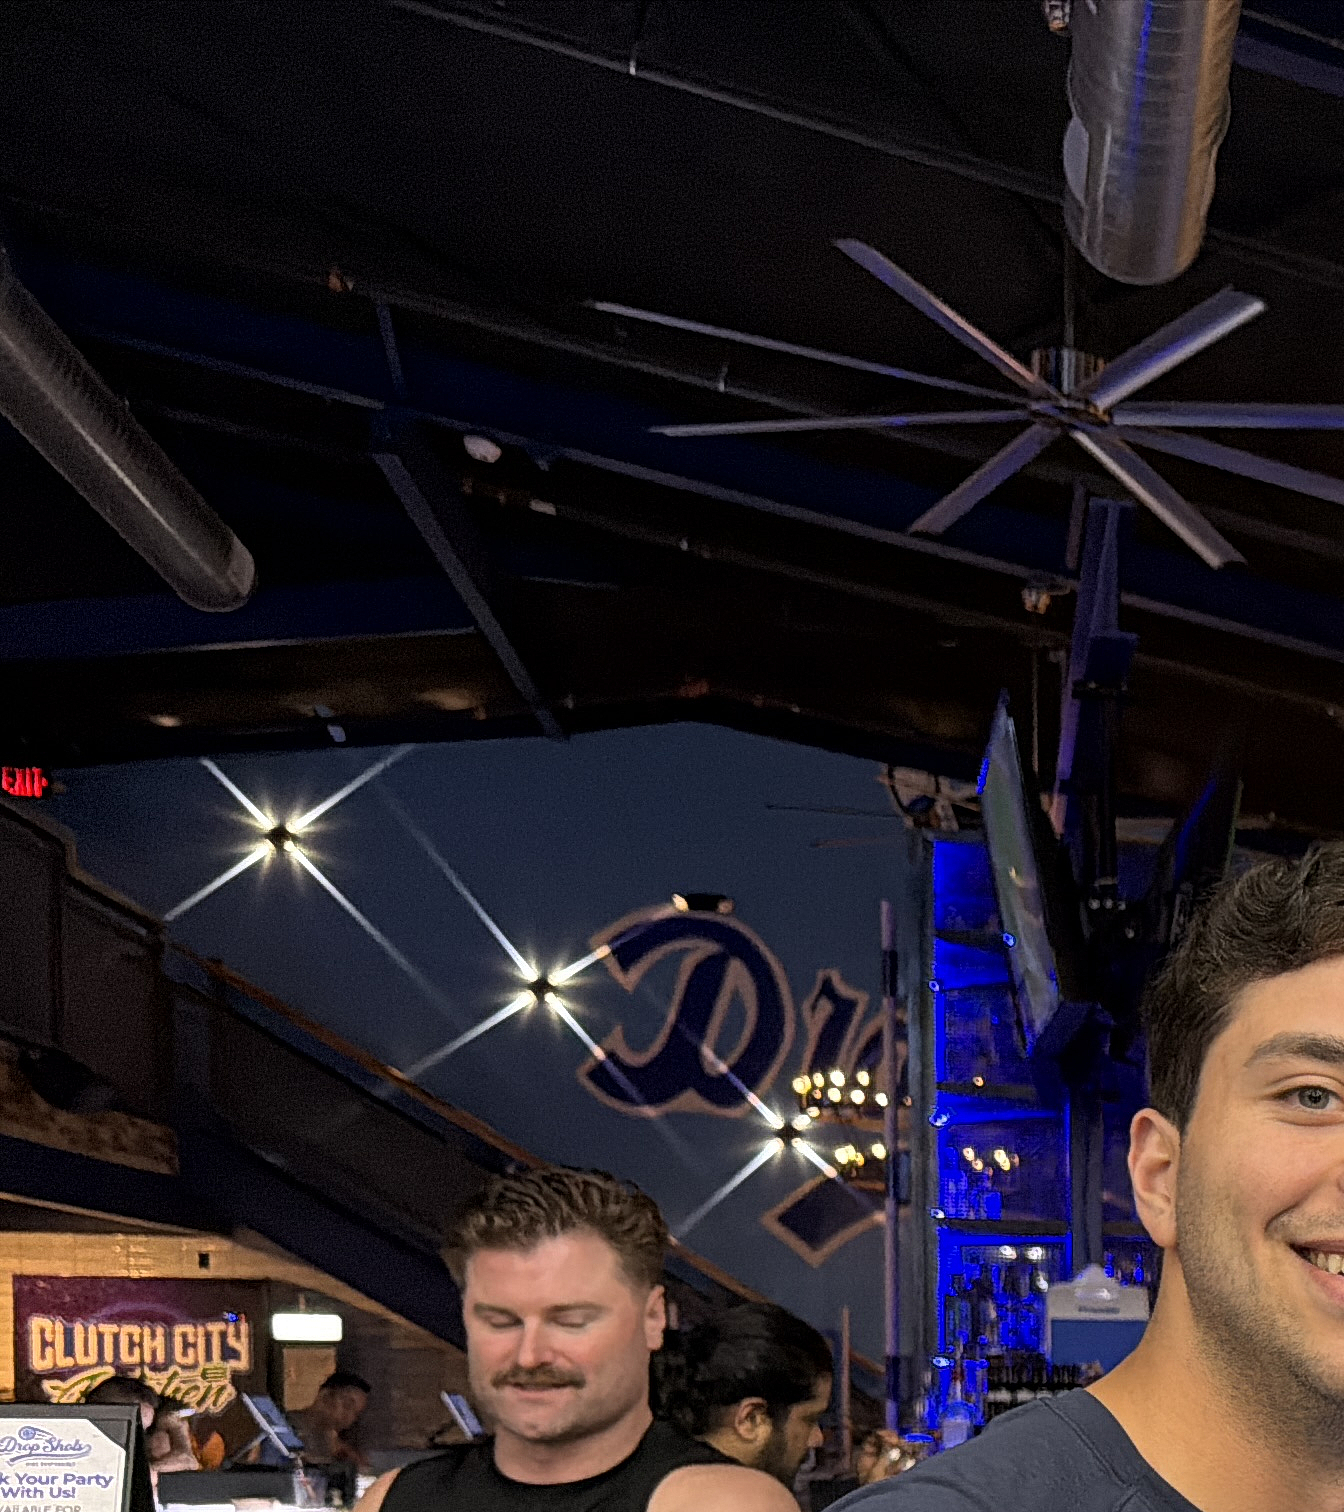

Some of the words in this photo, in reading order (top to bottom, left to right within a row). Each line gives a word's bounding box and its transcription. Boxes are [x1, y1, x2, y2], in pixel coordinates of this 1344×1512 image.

[2, 767, 42, 797] EXIT
[31, 1316, 166, 1372] CLUTCH
[174, 1318, 250, 1372] CITY
[15, 1473, 59, 1485] Your
[63, 1473, 114, 1488] Party
[1, 1486, 44, 1498] With
[50, 1487, 76, 1498] Us!
